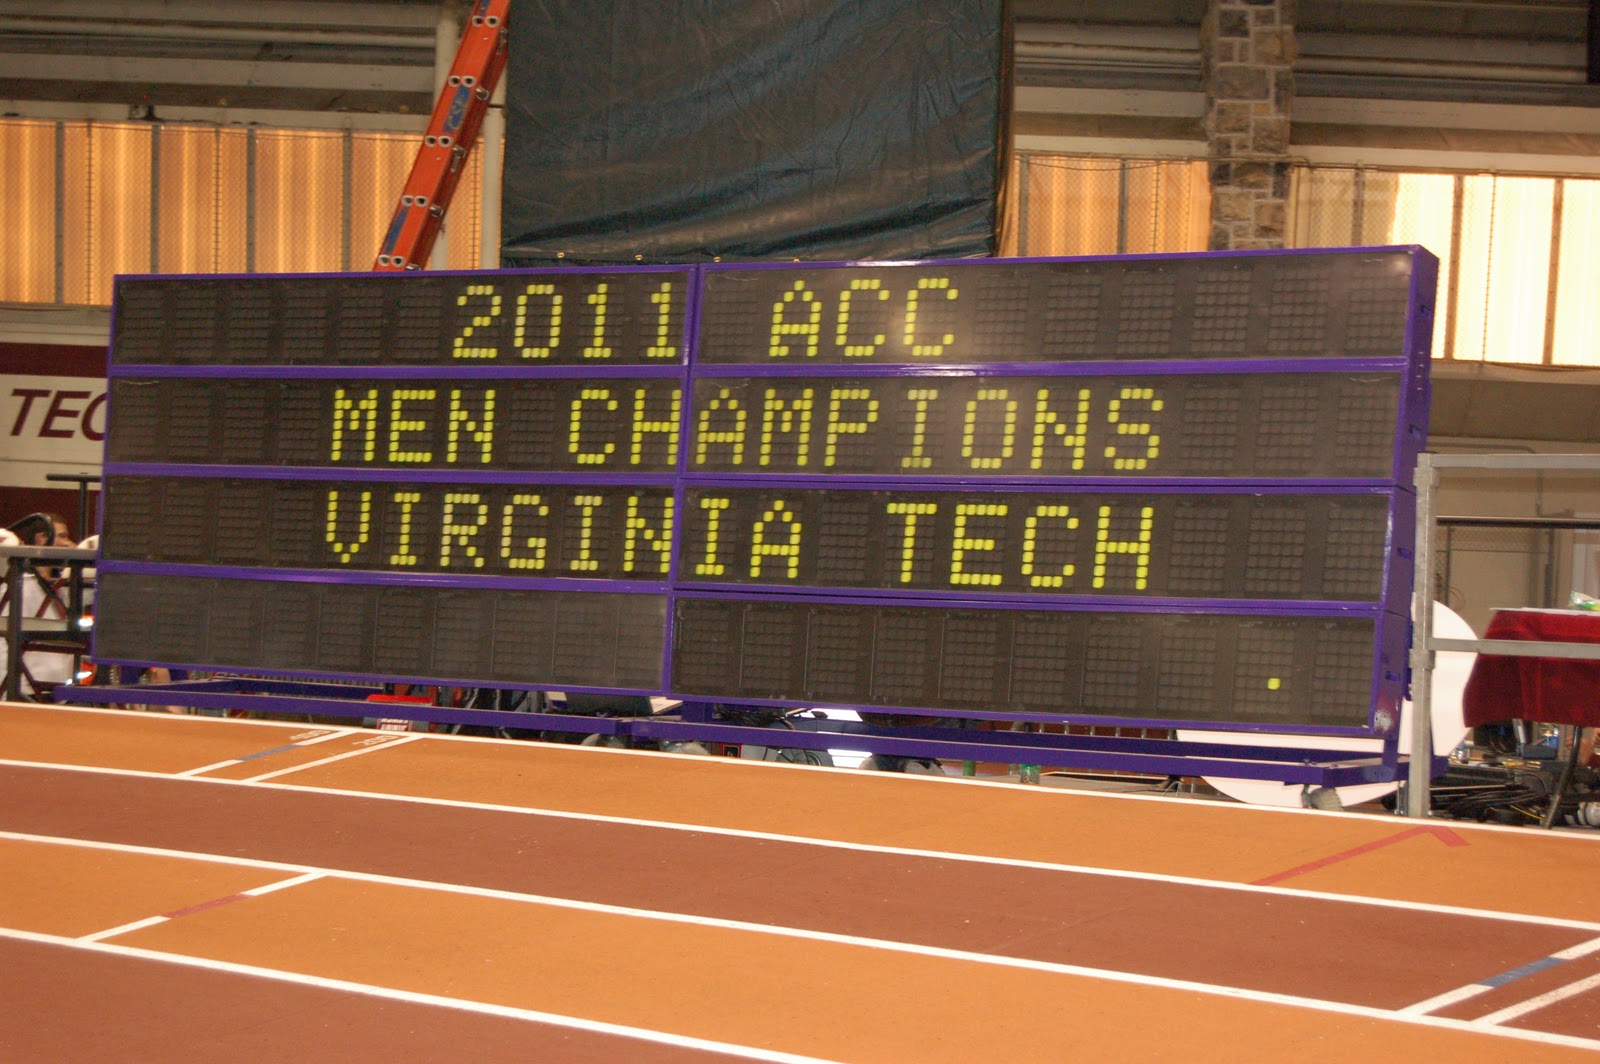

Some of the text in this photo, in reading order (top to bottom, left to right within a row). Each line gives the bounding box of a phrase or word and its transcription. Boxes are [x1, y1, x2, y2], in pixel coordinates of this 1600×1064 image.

[452, 277, 960, 360] 2011 ACC
[330, 387, 1165, 471] MEN CHAMPIONS
[325, 490, 1154, 591] VIRGINIA TECH
